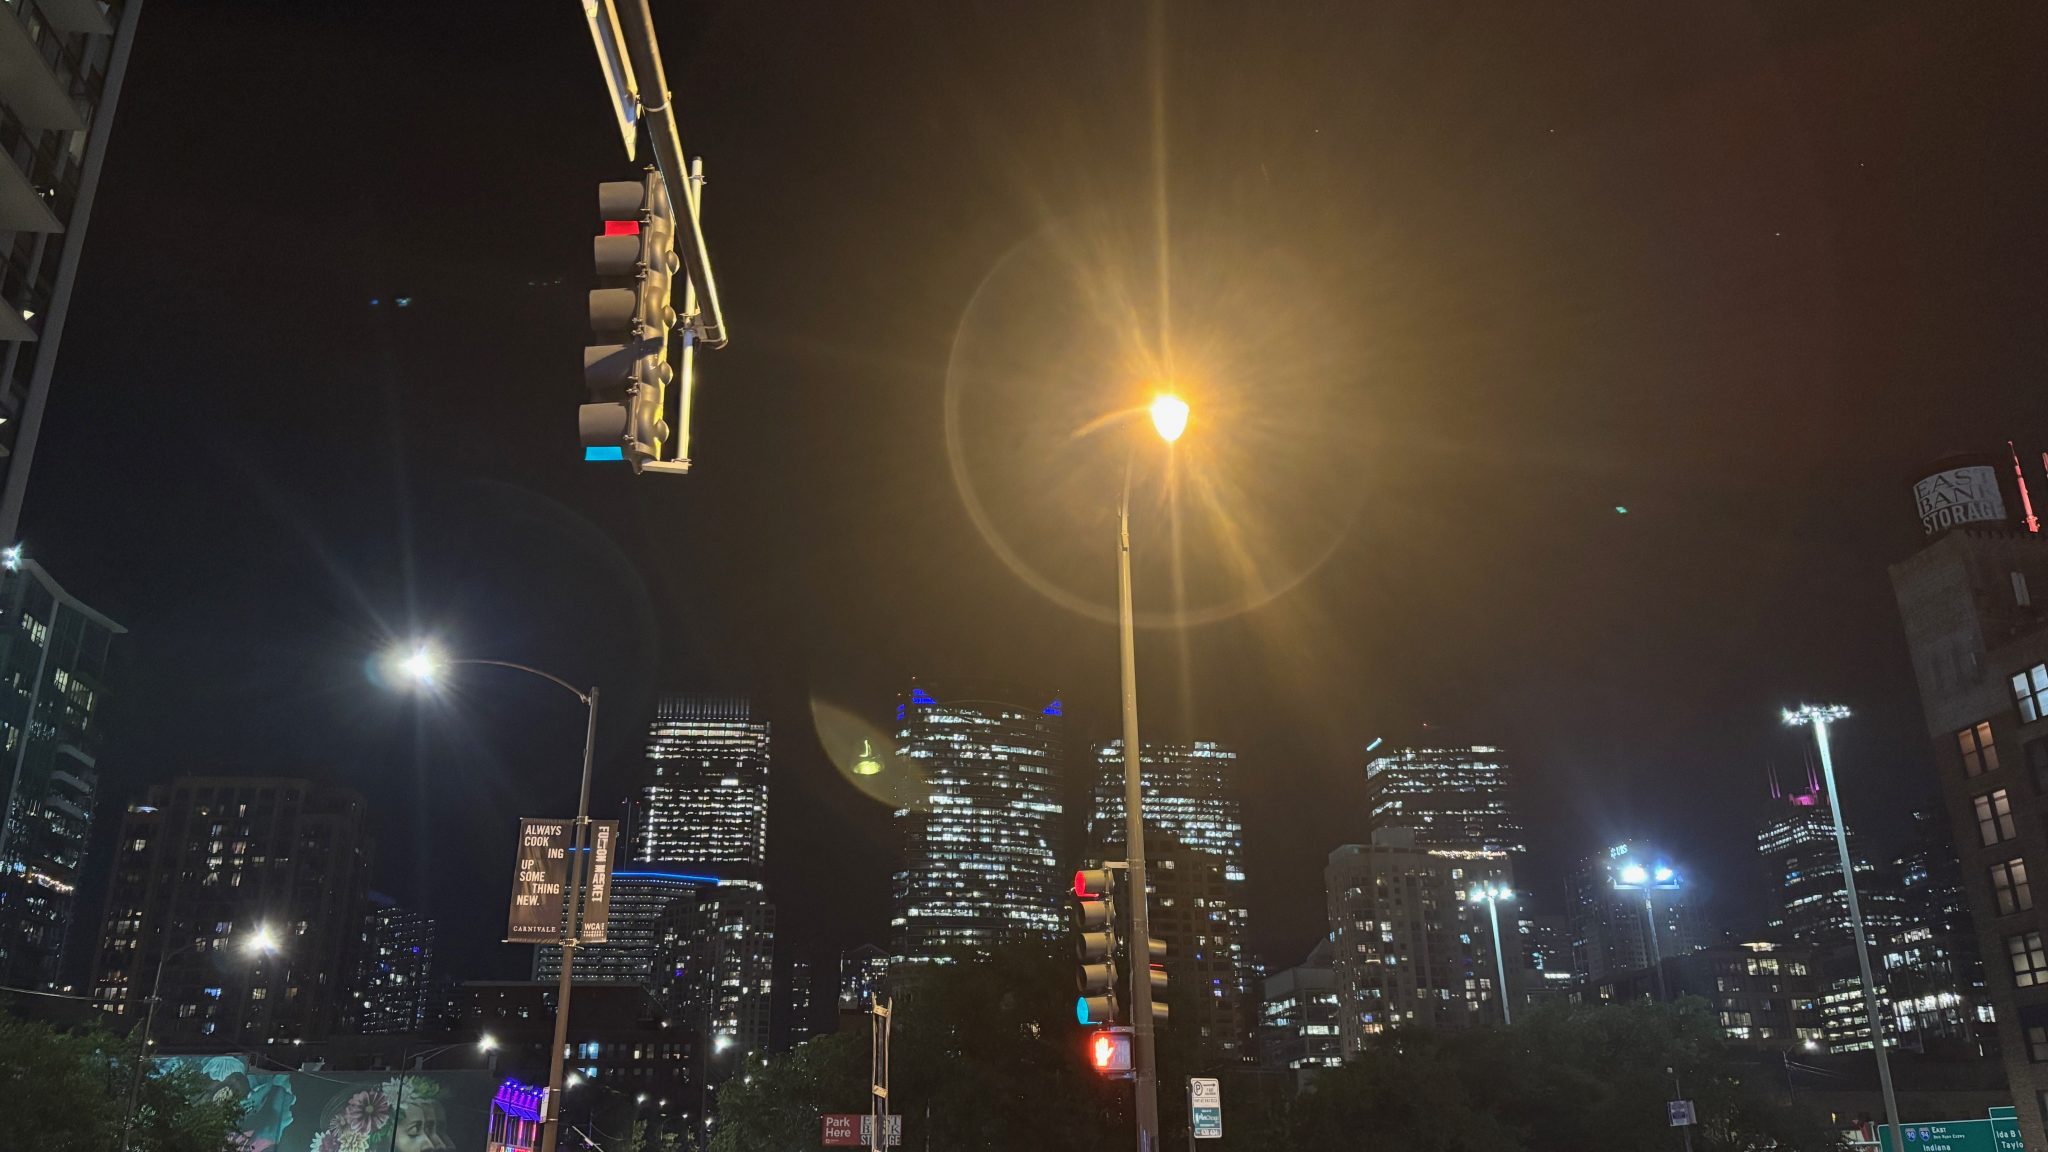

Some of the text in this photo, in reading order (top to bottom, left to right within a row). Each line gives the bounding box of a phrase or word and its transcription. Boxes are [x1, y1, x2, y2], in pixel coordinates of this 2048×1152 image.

[525, 824, 562, 836] ALWAYS
[525, 836, 550, 847] COOK
[547, 848, 564, 859] ING
[521, 859, 535, 870] UP
[591, 826, 610, 903] FULTON MARKET
[519, 871, 546, 882] SOME
[532, 883, 560, 895] THING
[516, 895, 540, 906] NEW.
[825, 1117, 851, 1127] Park
[825, 1127, 852, 1138] Here
[1906, 1131, 1915, 1139] 90
[1996, 1130, 2009, 1138] Ida
[2010, 1130, 2016, 1138] B
[860, 1135, 902, 1146] STGE
